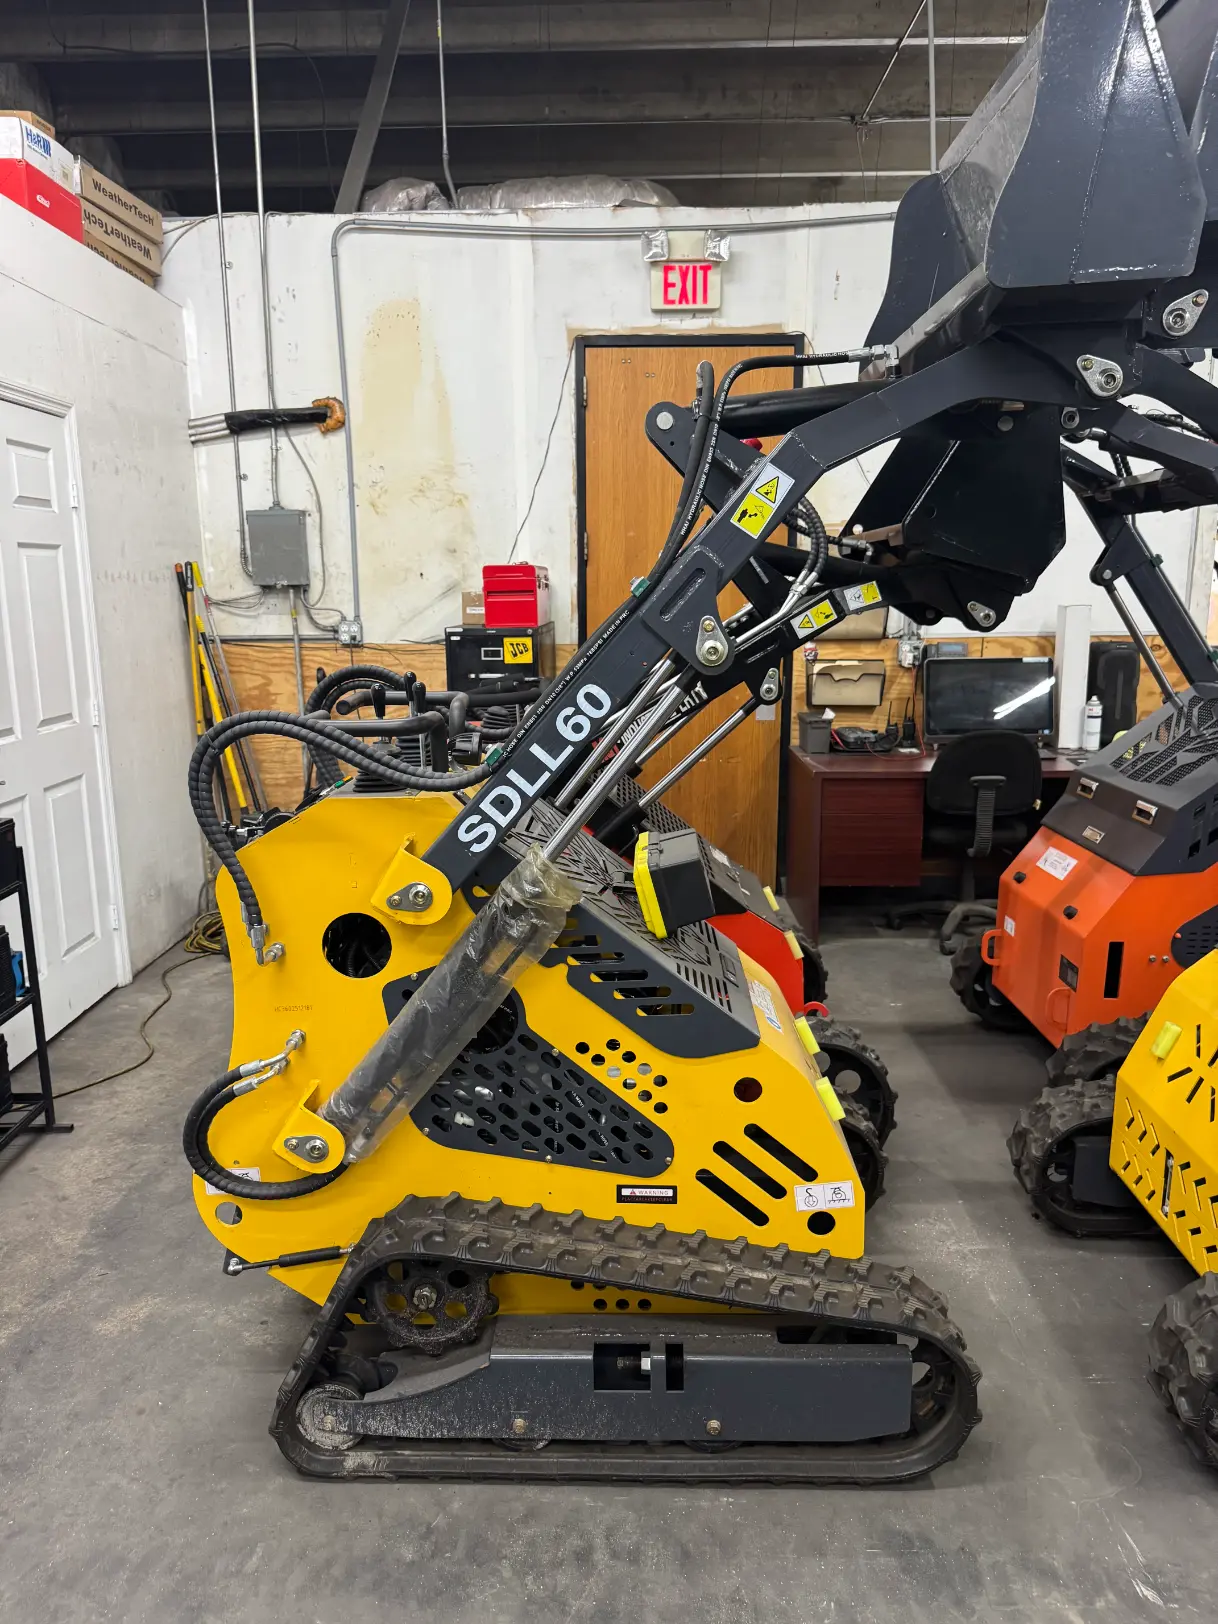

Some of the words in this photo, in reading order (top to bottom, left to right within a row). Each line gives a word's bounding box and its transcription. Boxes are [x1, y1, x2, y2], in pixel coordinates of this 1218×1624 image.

[92, 178, 154, 226] WeatherTech
[83, 208, 153, 261] WeatherTech
[663, 265, 713, 305] EXIT
[508, 641, 529, 658] JCB
[457, 683, 612, 853] SDLL60
